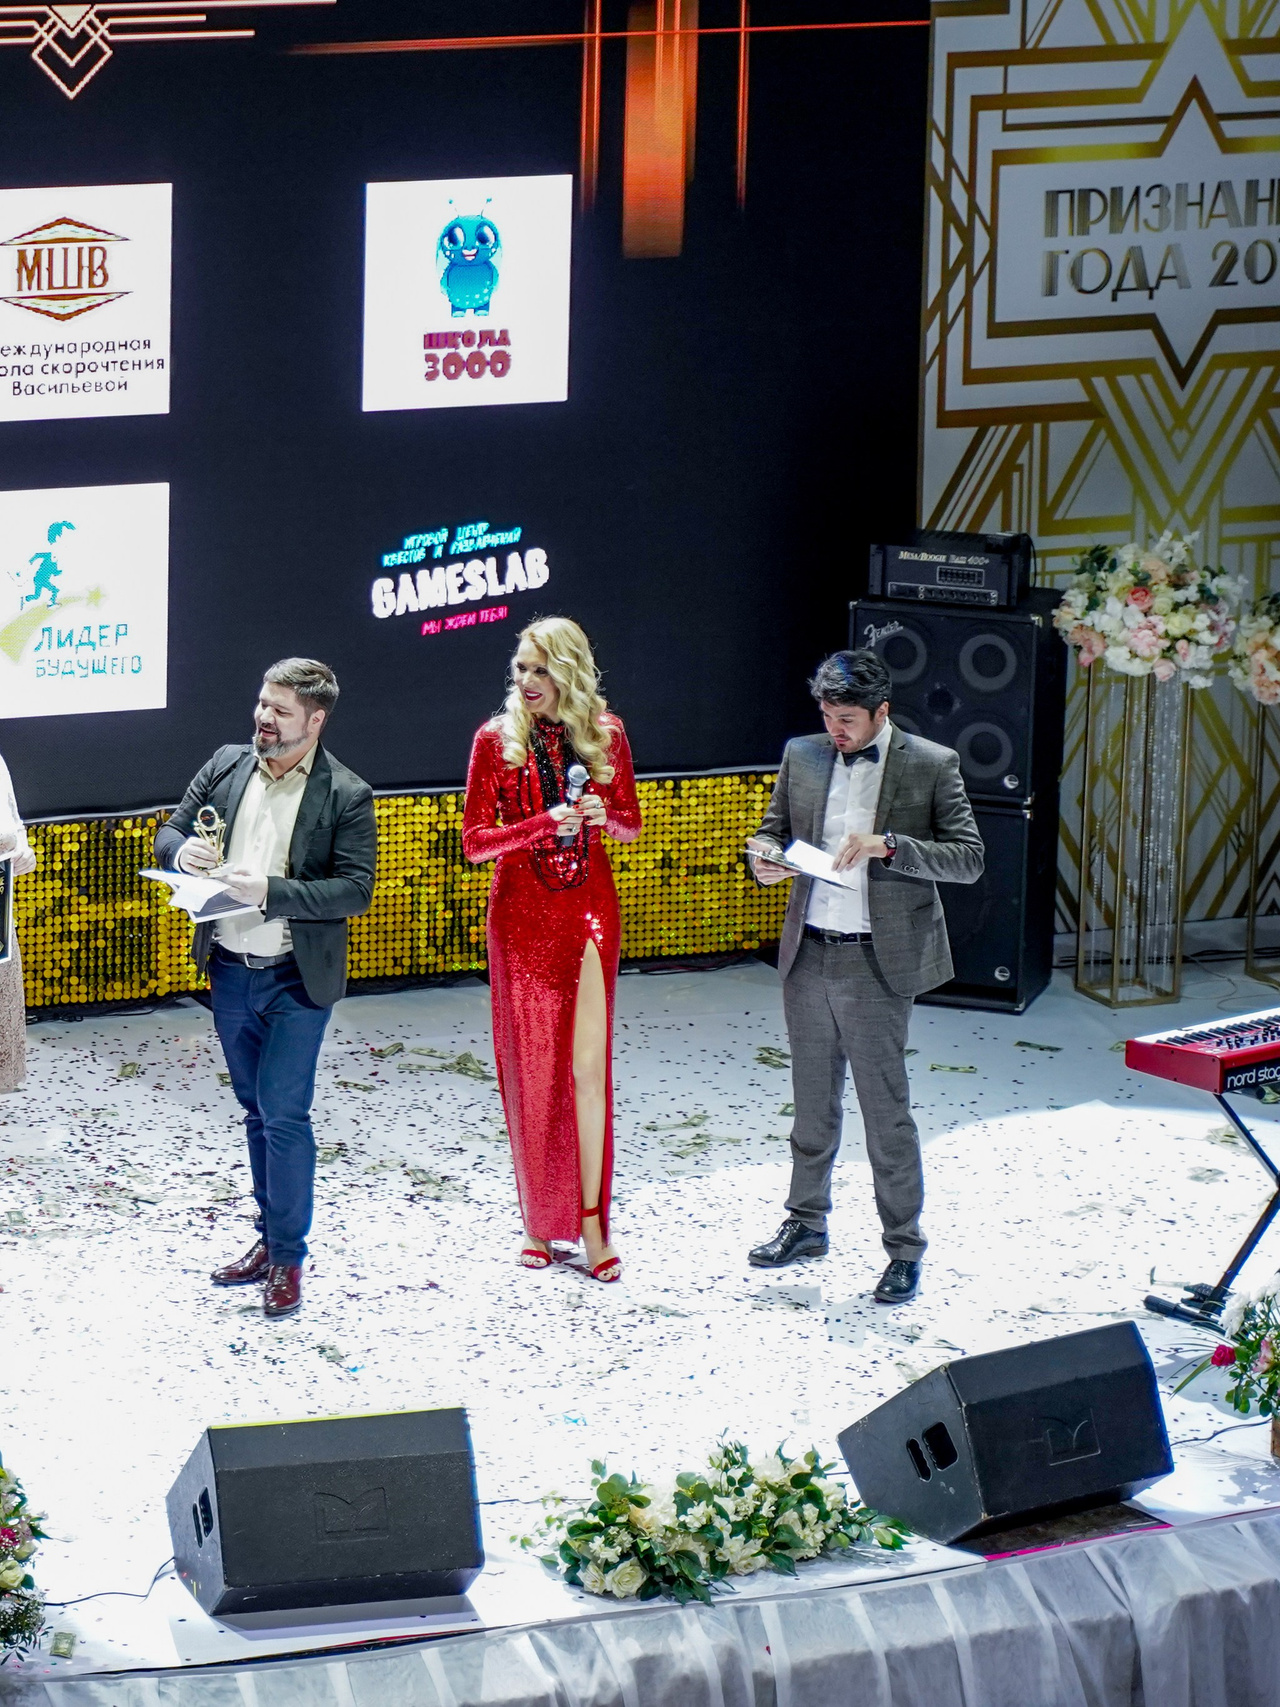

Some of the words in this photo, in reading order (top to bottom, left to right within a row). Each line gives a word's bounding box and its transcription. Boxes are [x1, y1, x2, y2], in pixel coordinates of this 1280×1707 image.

[1044, 178, 1280, 238] ПРИЗНАН
[1041, 243, 1192, 302] ГОДА
[1208, 237, 1280, 287] 20
[423, 329, 511, 349] ШКОЛА
[41, 358, 165, 378] скорочтения
[424, 350, 511, 381] 3000
[12, 376, 128, 396] Васильевой
[372, 548, 550, 619] GAMESLAB
[34, 624, 128, 654] ЛИДЕР
[1227, 1068, 1256, 1089] nord
